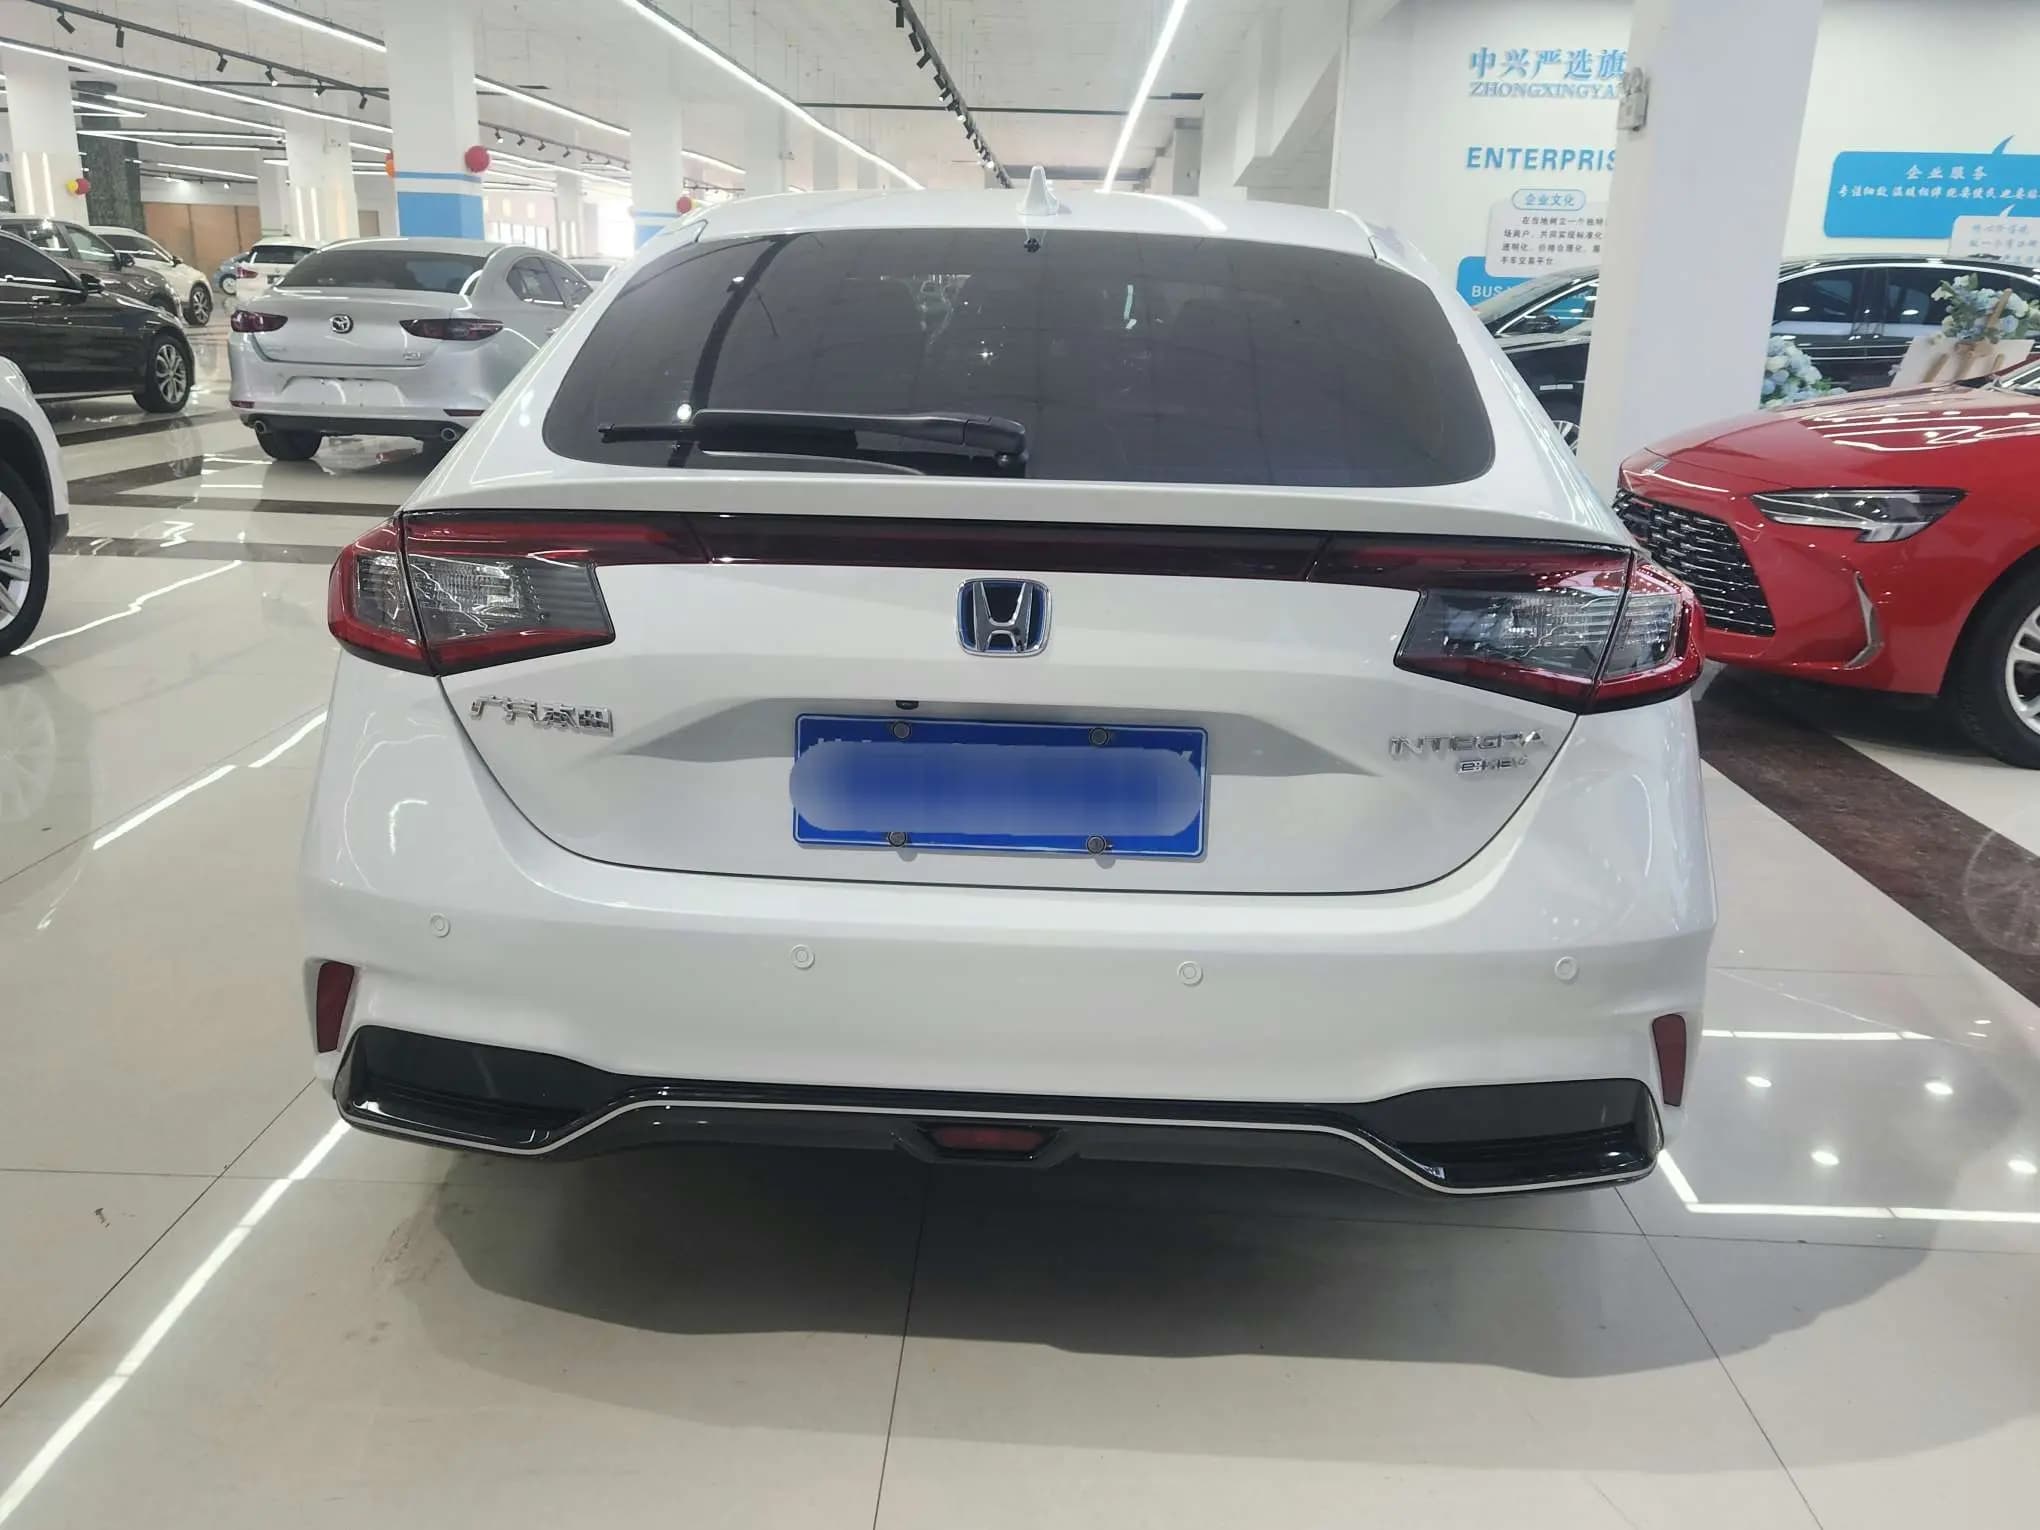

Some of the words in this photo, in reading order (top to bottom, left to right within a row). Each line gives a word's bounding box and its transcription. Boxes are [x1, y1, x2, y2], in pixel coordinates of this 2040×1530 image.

[1469, 46, 1627, 80] 中兴严选旗
[1905, 164, 1988, 180] 企业服务
[1524, 192, 1575, 207] 企业文化
